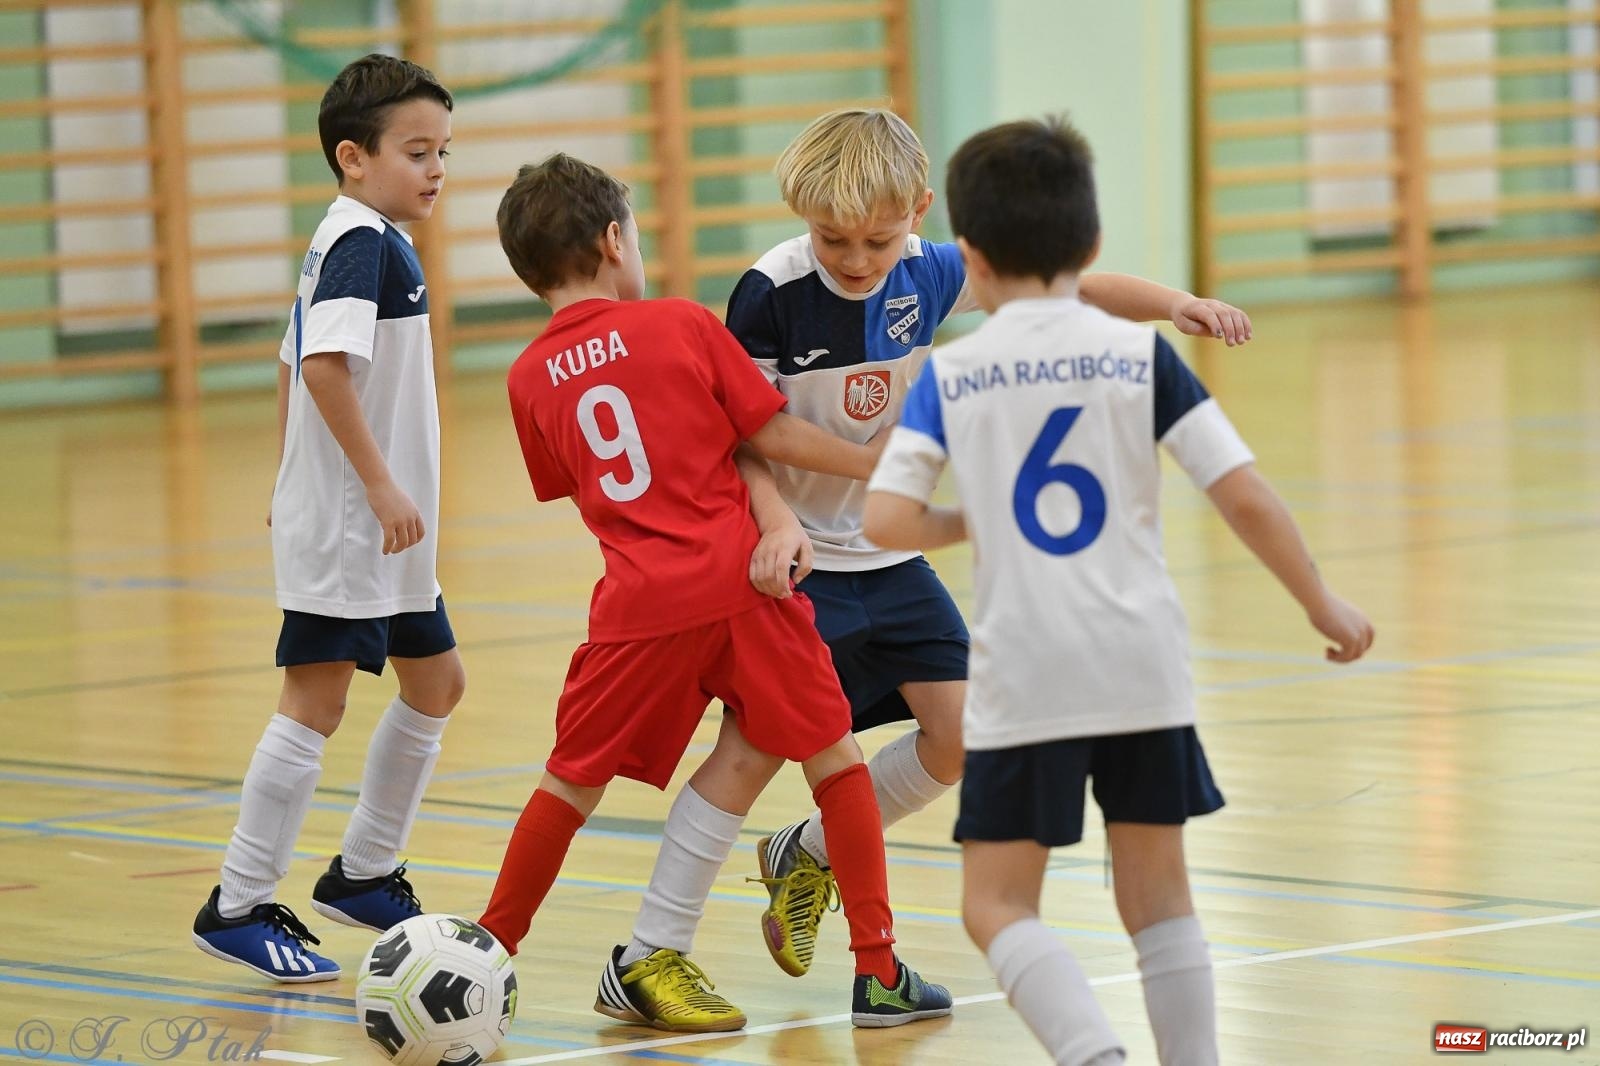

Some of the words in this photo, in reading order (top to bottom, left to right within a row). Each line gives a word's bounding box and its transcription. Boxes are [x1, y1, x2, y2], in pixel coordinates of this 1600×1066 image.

[890, 313, 917, 335] UNIA
[546, 330, 629, 387] KUBA
[942, 363, 1008, 402] UNIA
[1013, 351, 1149, 385] RACIBÓRZ
[576, 384, 652, 502] 9
[1012, 406, 1107, 557] 6
